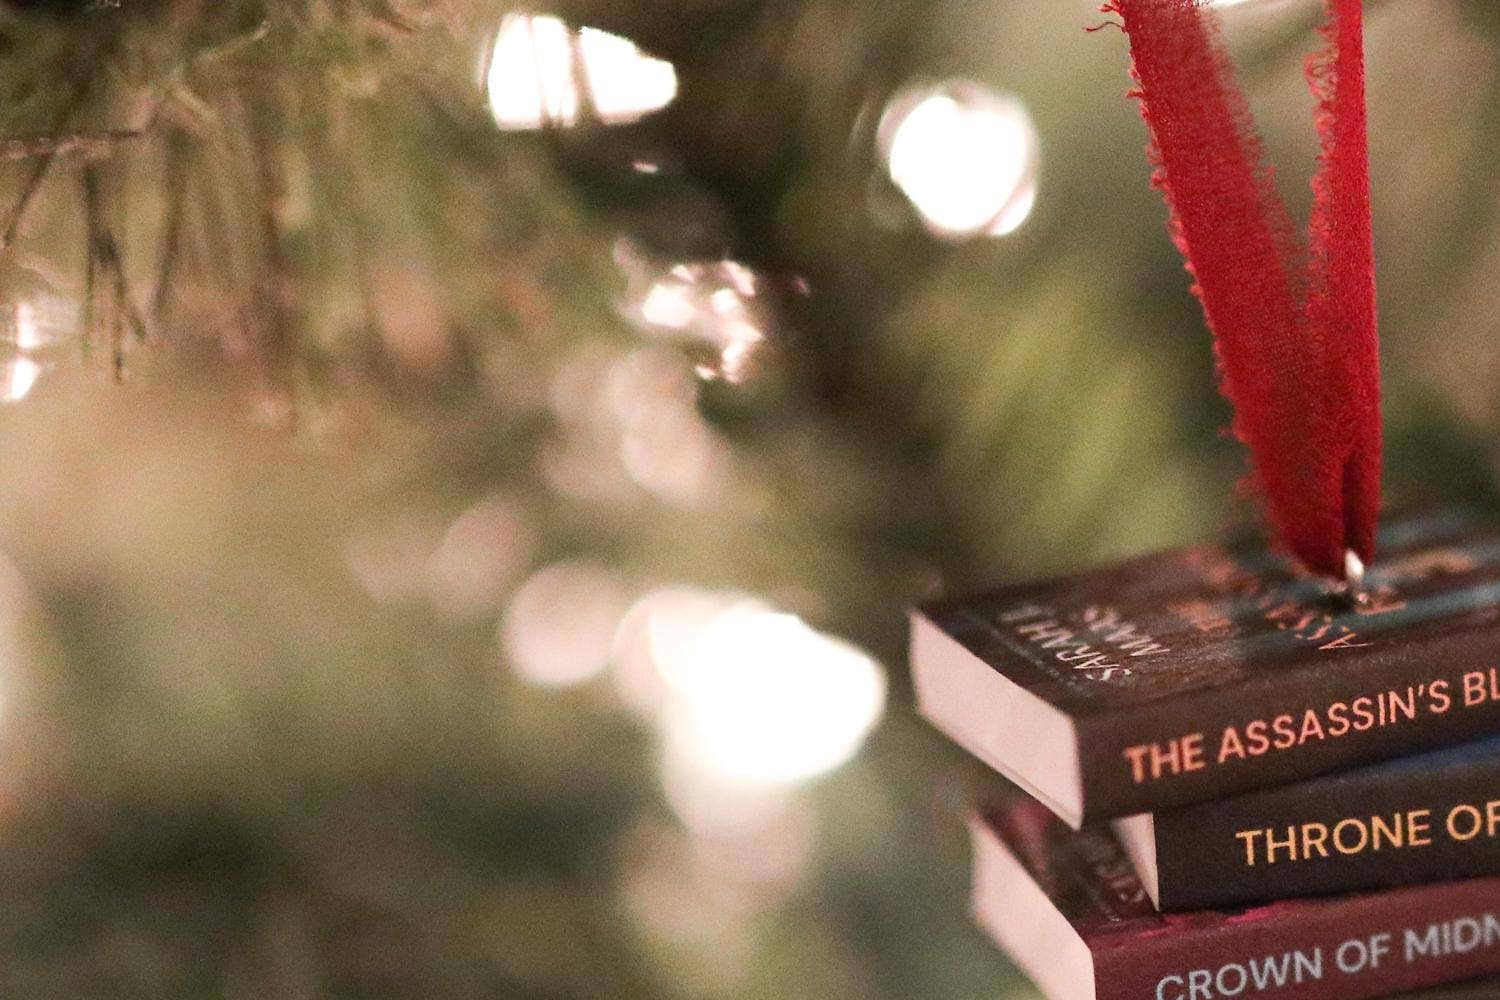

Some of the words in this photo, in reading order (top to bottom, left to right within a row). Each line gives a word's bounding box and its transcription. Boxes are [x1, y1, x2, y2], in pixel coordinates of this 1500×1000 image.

[1123, 732, 1206, 784] THE
[1217, 679, 1451, 764] ASSASSIN'S
[1236, 809, 1432, 866] THRONE
[1336, 933, 1391, 974] OF
